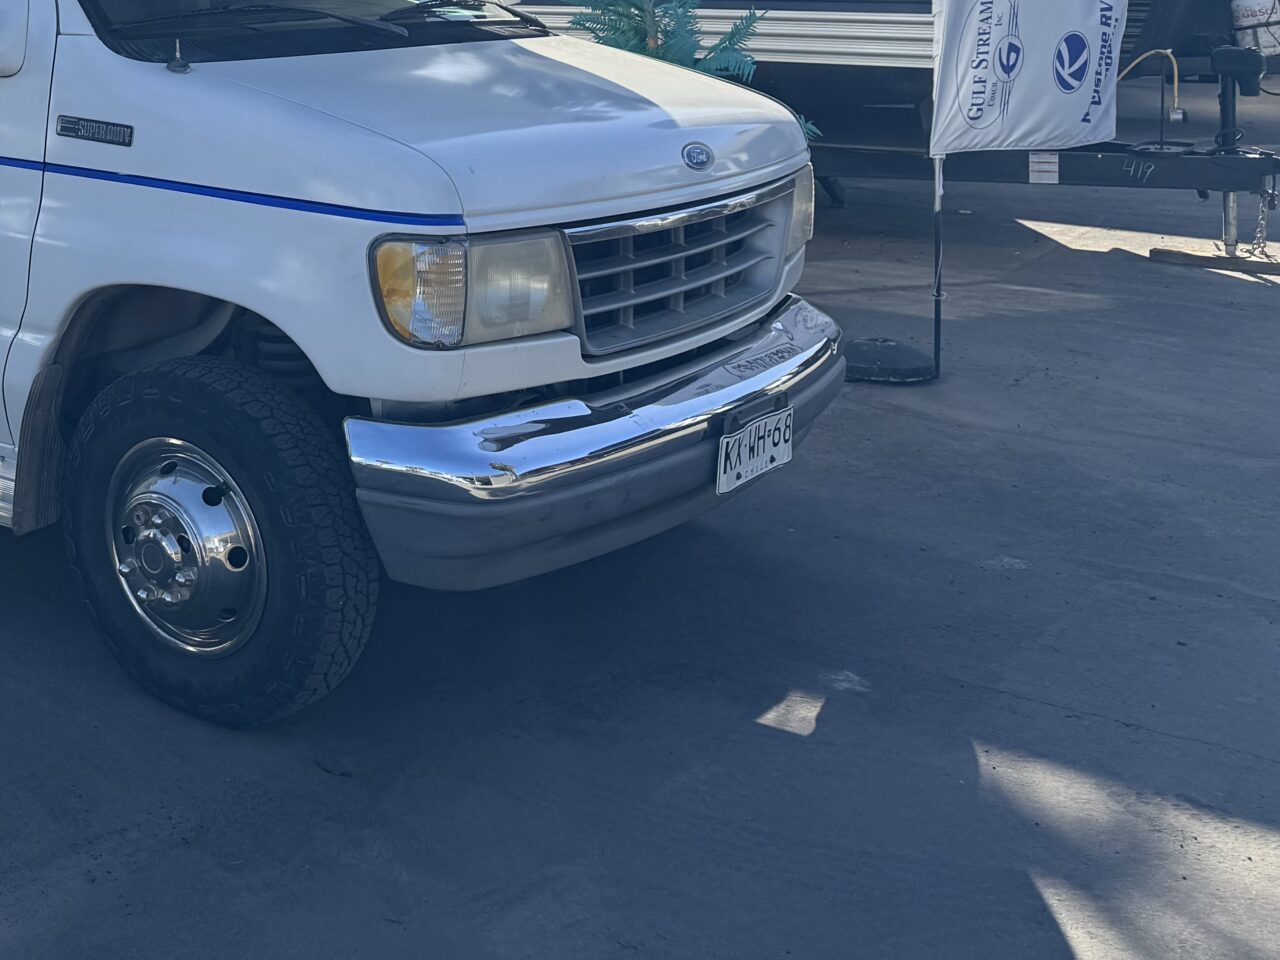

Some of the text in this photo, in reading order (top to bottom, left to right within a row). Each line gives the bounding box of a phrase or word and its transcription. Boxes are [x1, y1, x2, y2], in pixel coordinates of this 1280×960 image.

[1099, 0, 1114, 27] RV
[967, 0, 994, 121] GULF STREAM
[1122, 159, 1155, 183] 419
